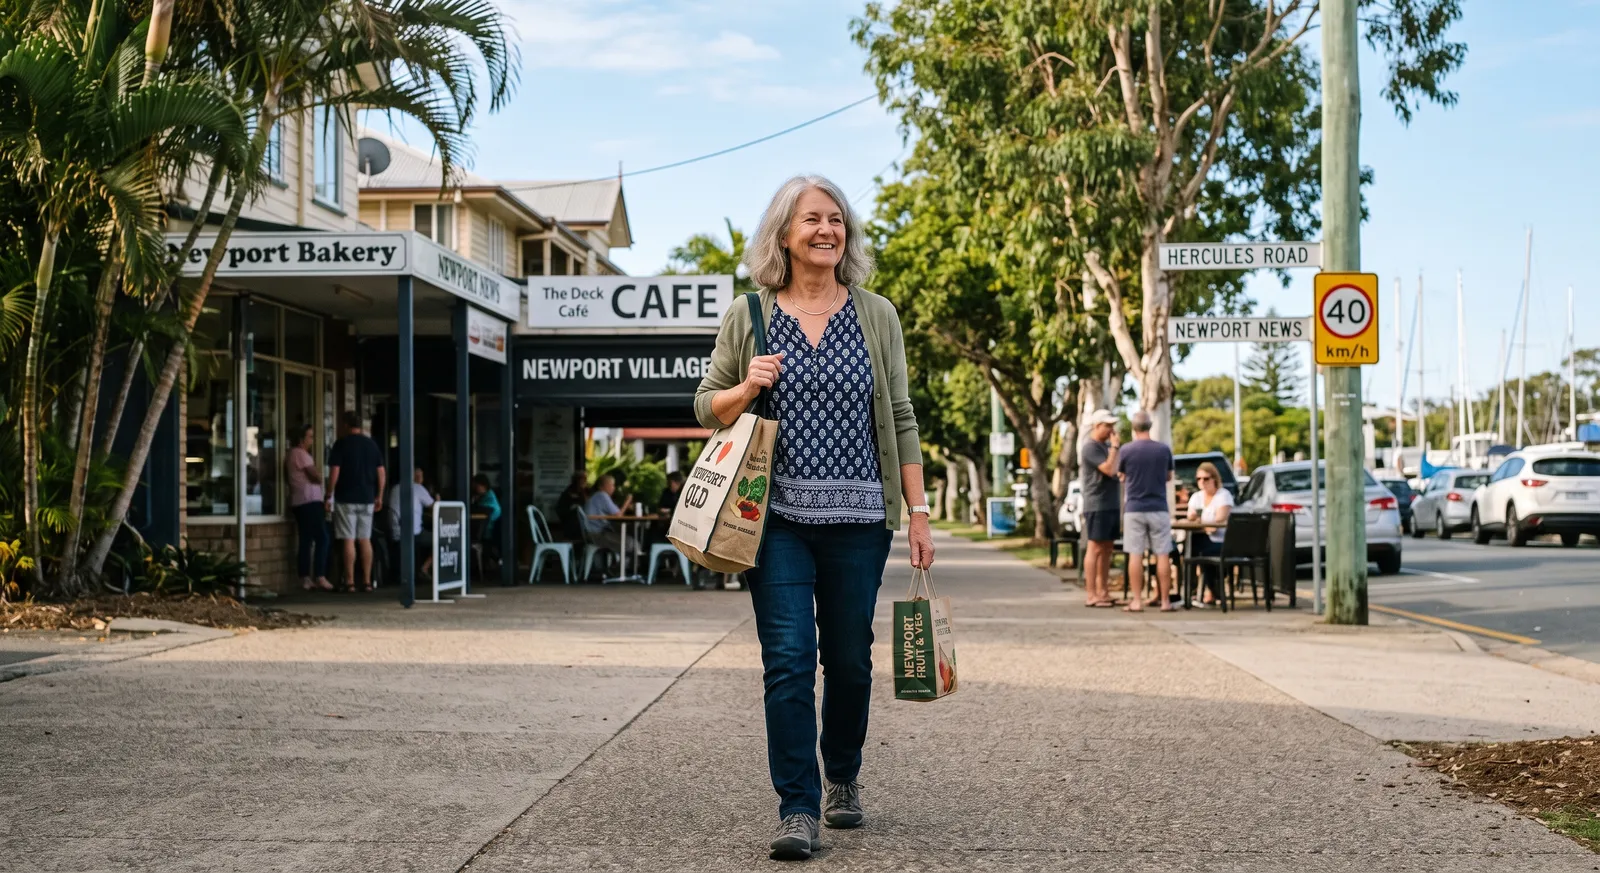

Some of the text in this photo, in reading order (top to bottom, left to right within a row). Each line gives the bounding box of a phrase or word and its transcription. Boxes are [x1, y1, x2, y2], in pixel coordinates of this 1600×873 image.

[297, 242, 397, 267] Bakery
[1168, 247, 1308, 265] HERCULES ROAD
[438, 251, 501, 293] NEWPORT NEWS
[542, 286, 604, 300] The Deck
[611, 283, 719, 319] CAFE
[558, 304, 589, 318] Café
[1326, 299, 1366, 324] 40
[1175, 321, 1303, 338] NEWPORT NEWS
[1326, 344, 1370, 359] km/h
[522, 356, 712, 380] NEWPORT VILLAGE
[705, 441, 722, 462] I
[684, 483, 709, 509] QLD
[903, 616, 915, 678] NEWPORT
[914, 612, 926, 678] FRUIT & VEG
